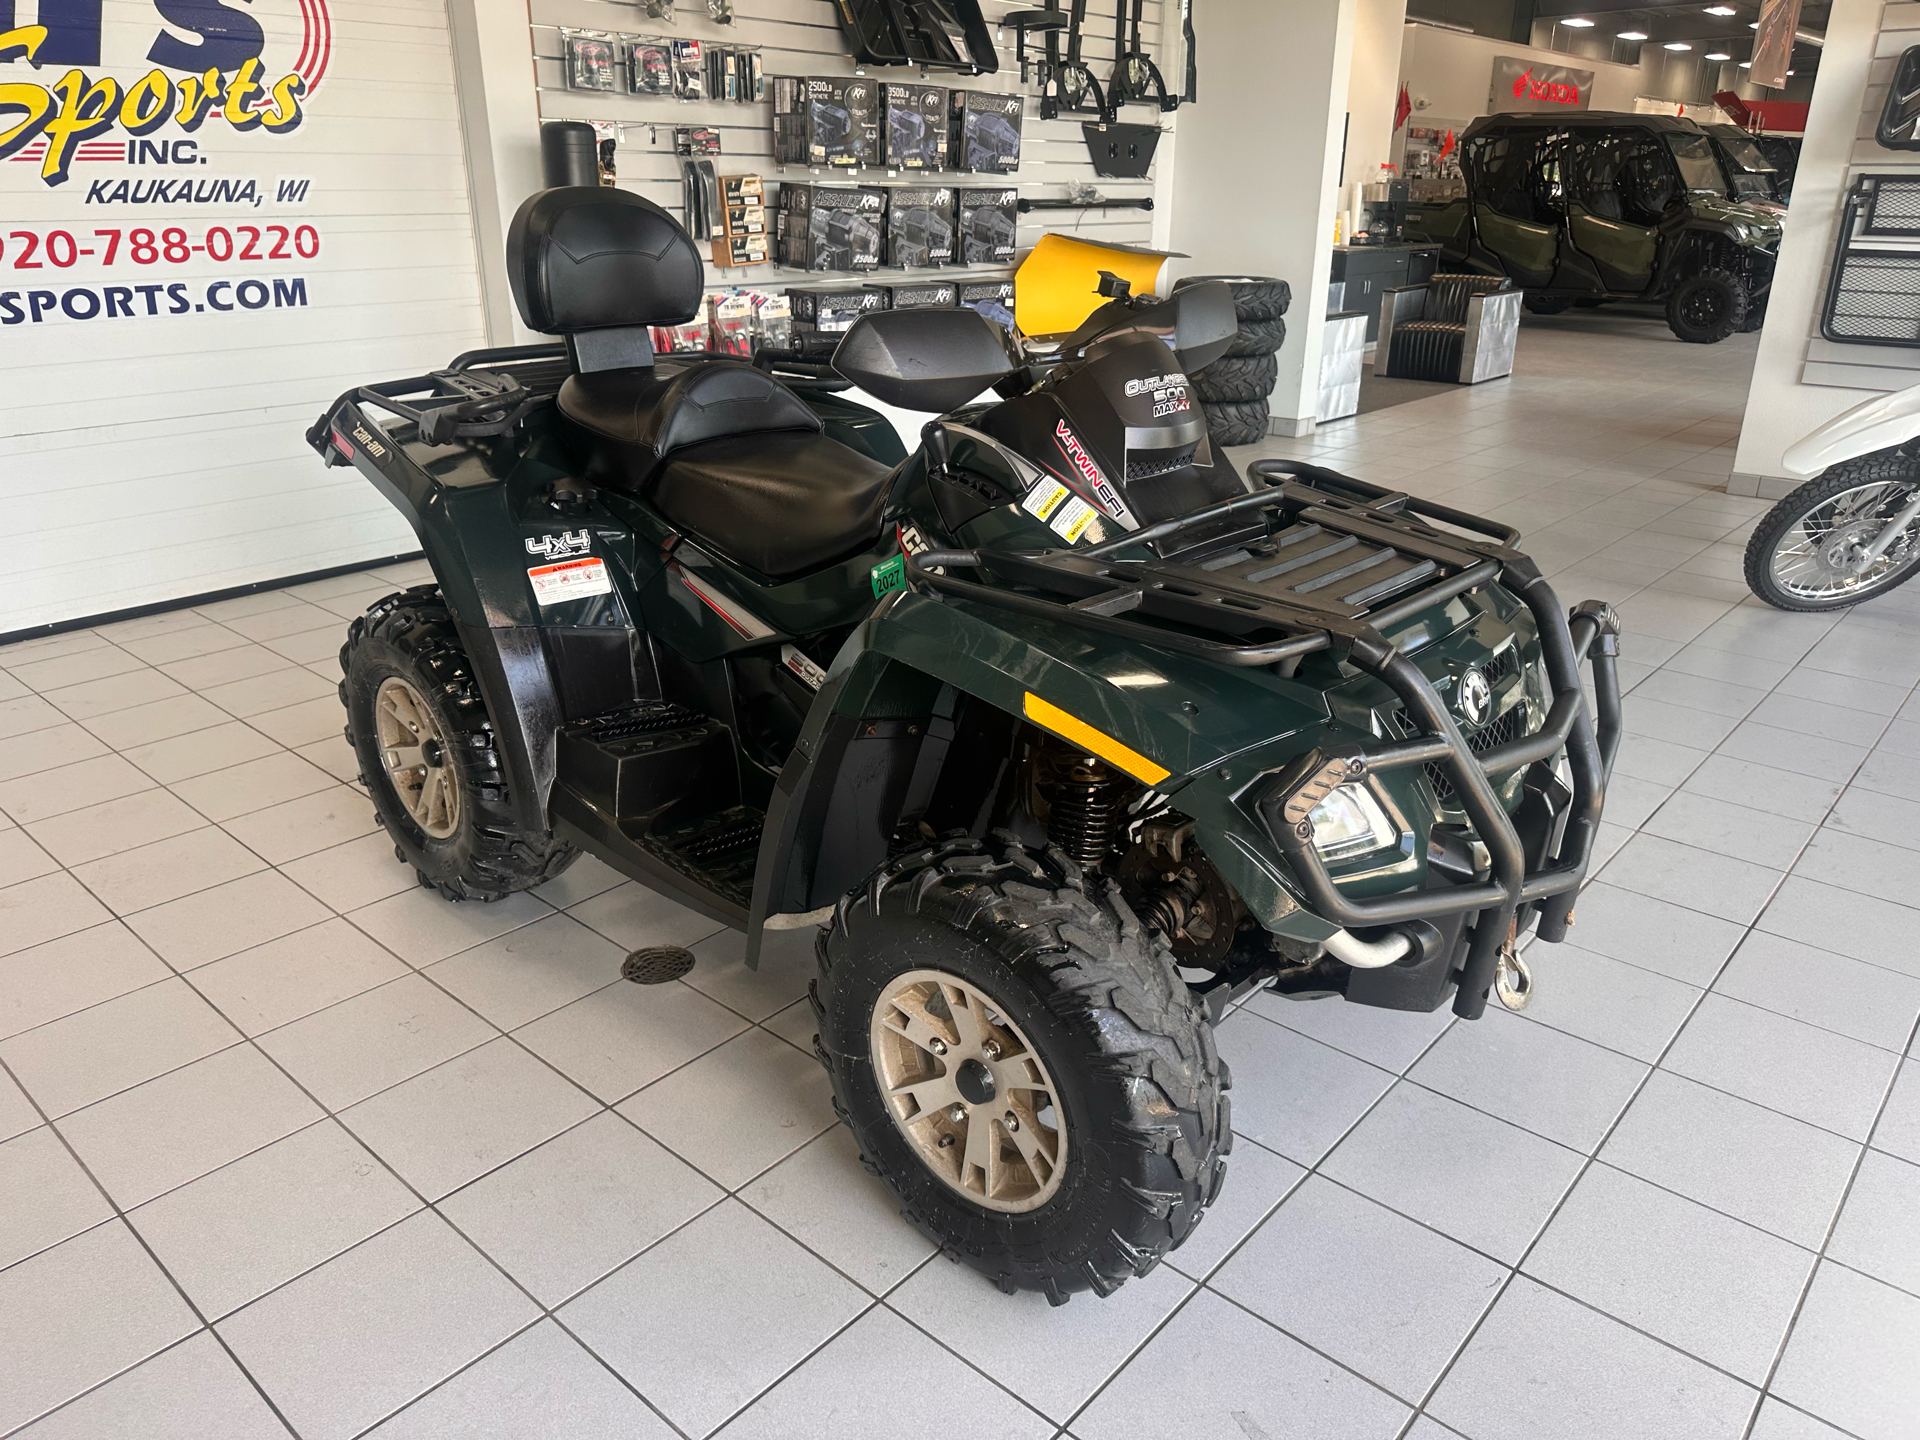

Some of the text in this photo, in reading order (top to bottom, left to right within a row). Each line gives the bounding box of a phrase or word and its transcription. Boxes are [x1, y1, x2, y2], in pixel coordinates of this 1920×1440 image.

[808, 81, 833, 92] 2500LB
[888, 87, 910, 98] 3500LB
[1529, 80, 1579, 105] HONDA
[0, 25, 305, 187] Sports
[968, 94, 1006, 111] ASSAULT
[128, 139, 207, 165] INC.
[86, 180, 310, 207] KAUKAUNA, WI
[812, 190, 862, 207] ASSAULT
[891, 191, 936, 205] ASSAULT
[961, 191, 1001, 206] ASSAULT
[854, 254, 879, 264] 2500LB
[894, 290, 937, 304] ASSAULT
[961, 286, 1000, 300] ASSAULT
[818, 295, 863, 310] ASSAULT
[1153, 386, 1187, 405] 500
[1042, 491, 1063, 515] CAUTION
[1070, 513, 1092, 538] CAUTION
[557, 562, 583, 572] WARNING
[876, 570, 901, 594] 2027
